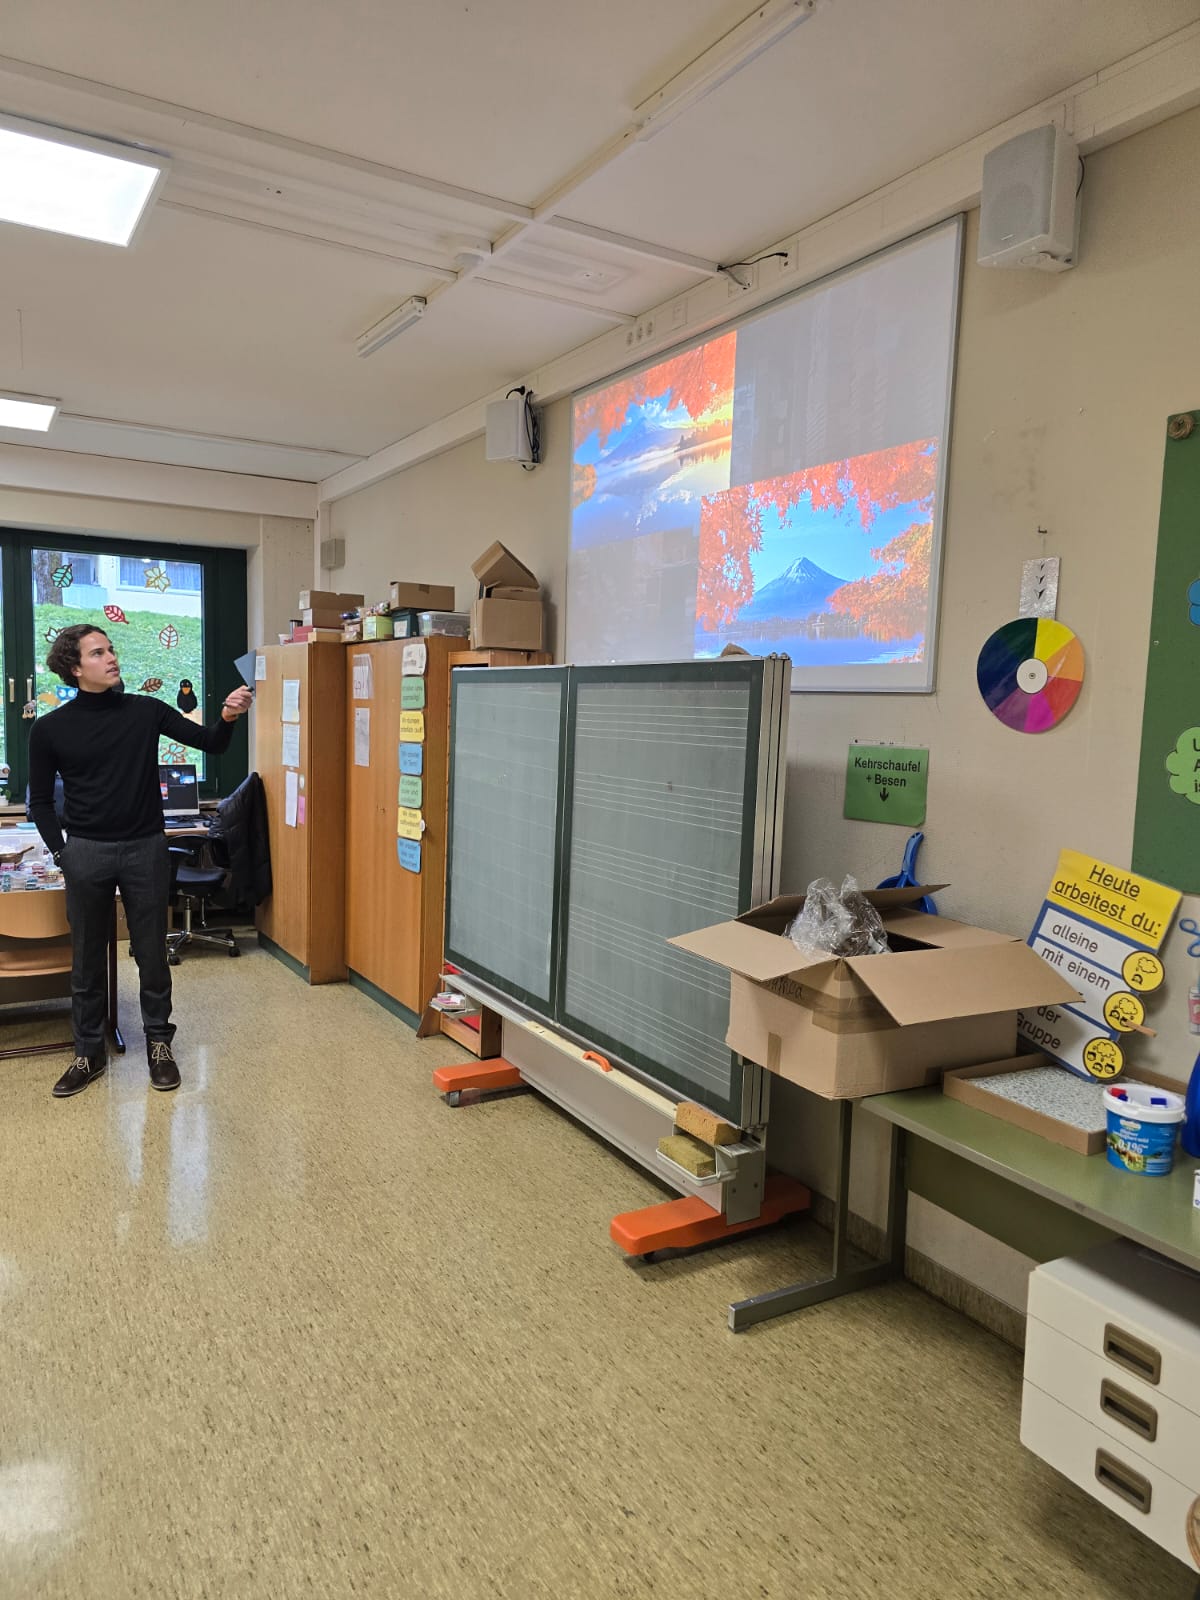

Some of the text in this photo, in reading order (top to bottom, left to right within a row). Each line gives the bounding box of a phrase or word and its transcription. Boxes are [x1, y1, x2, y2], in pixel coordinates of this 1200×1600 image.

[854, 756, 921, 773] Kehrschaufel
[866, 773, 907, 788] + Besen
[1088, 864, 1141, 899] Heute
[1054, 880, 1162, 936] arbeitest du:
[1052, 924, 1098, 953] alleine
[1041, 947, 1111, 991] mit einem
